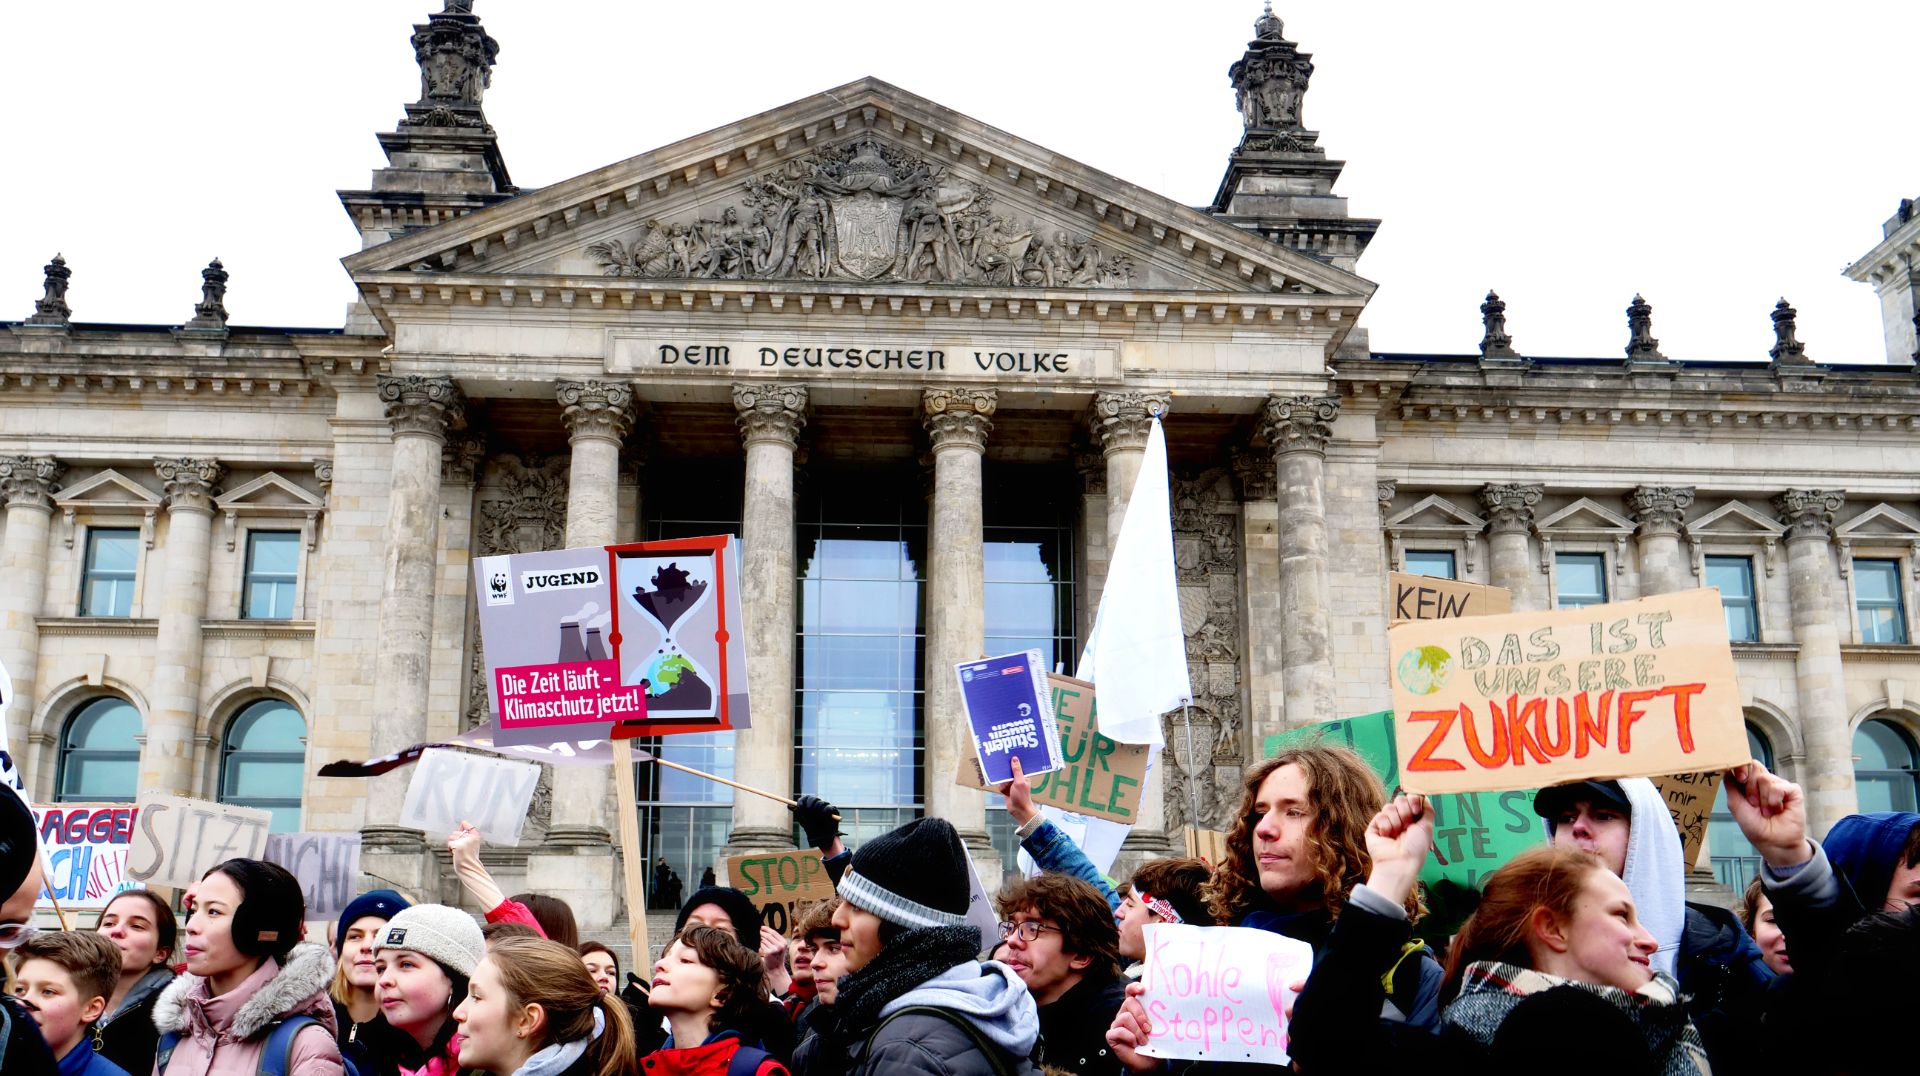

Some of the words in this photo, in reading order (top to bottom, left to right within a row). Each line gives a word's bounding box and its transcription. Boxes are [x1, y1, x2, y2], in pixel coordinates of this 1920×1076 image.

[658, 345, 730, 366] DEM
[758, 347, 945, 371] DEUTSCHEN
[974, 352, 1069, 373] VOLKE
[526, 571, 600, 589] JUGEND
[1396, 583, 1471, 620] KEIN
[1461, 626, 1560, 670] DAS
[1590, 610, 1673, 655] IST
[501, 674, 527, 696] Die
[530, 671, 561, 694] Zeit
[562, 667, 600, 691] läuft
[1474, 654, 1665, 697] UNSERE
[504, 694, 595, 720] Klimaschutz
[596, 688, 640, 718] jetzt!
[1406, 683, 1707, 772] ZUKUNFT
[1669, 791, 1697, 806] mir
[127, 803, 269, 882] SITZT
[740, 855, 820, 896] STOP
[1149, 930, 1243, 1004] Kohle
